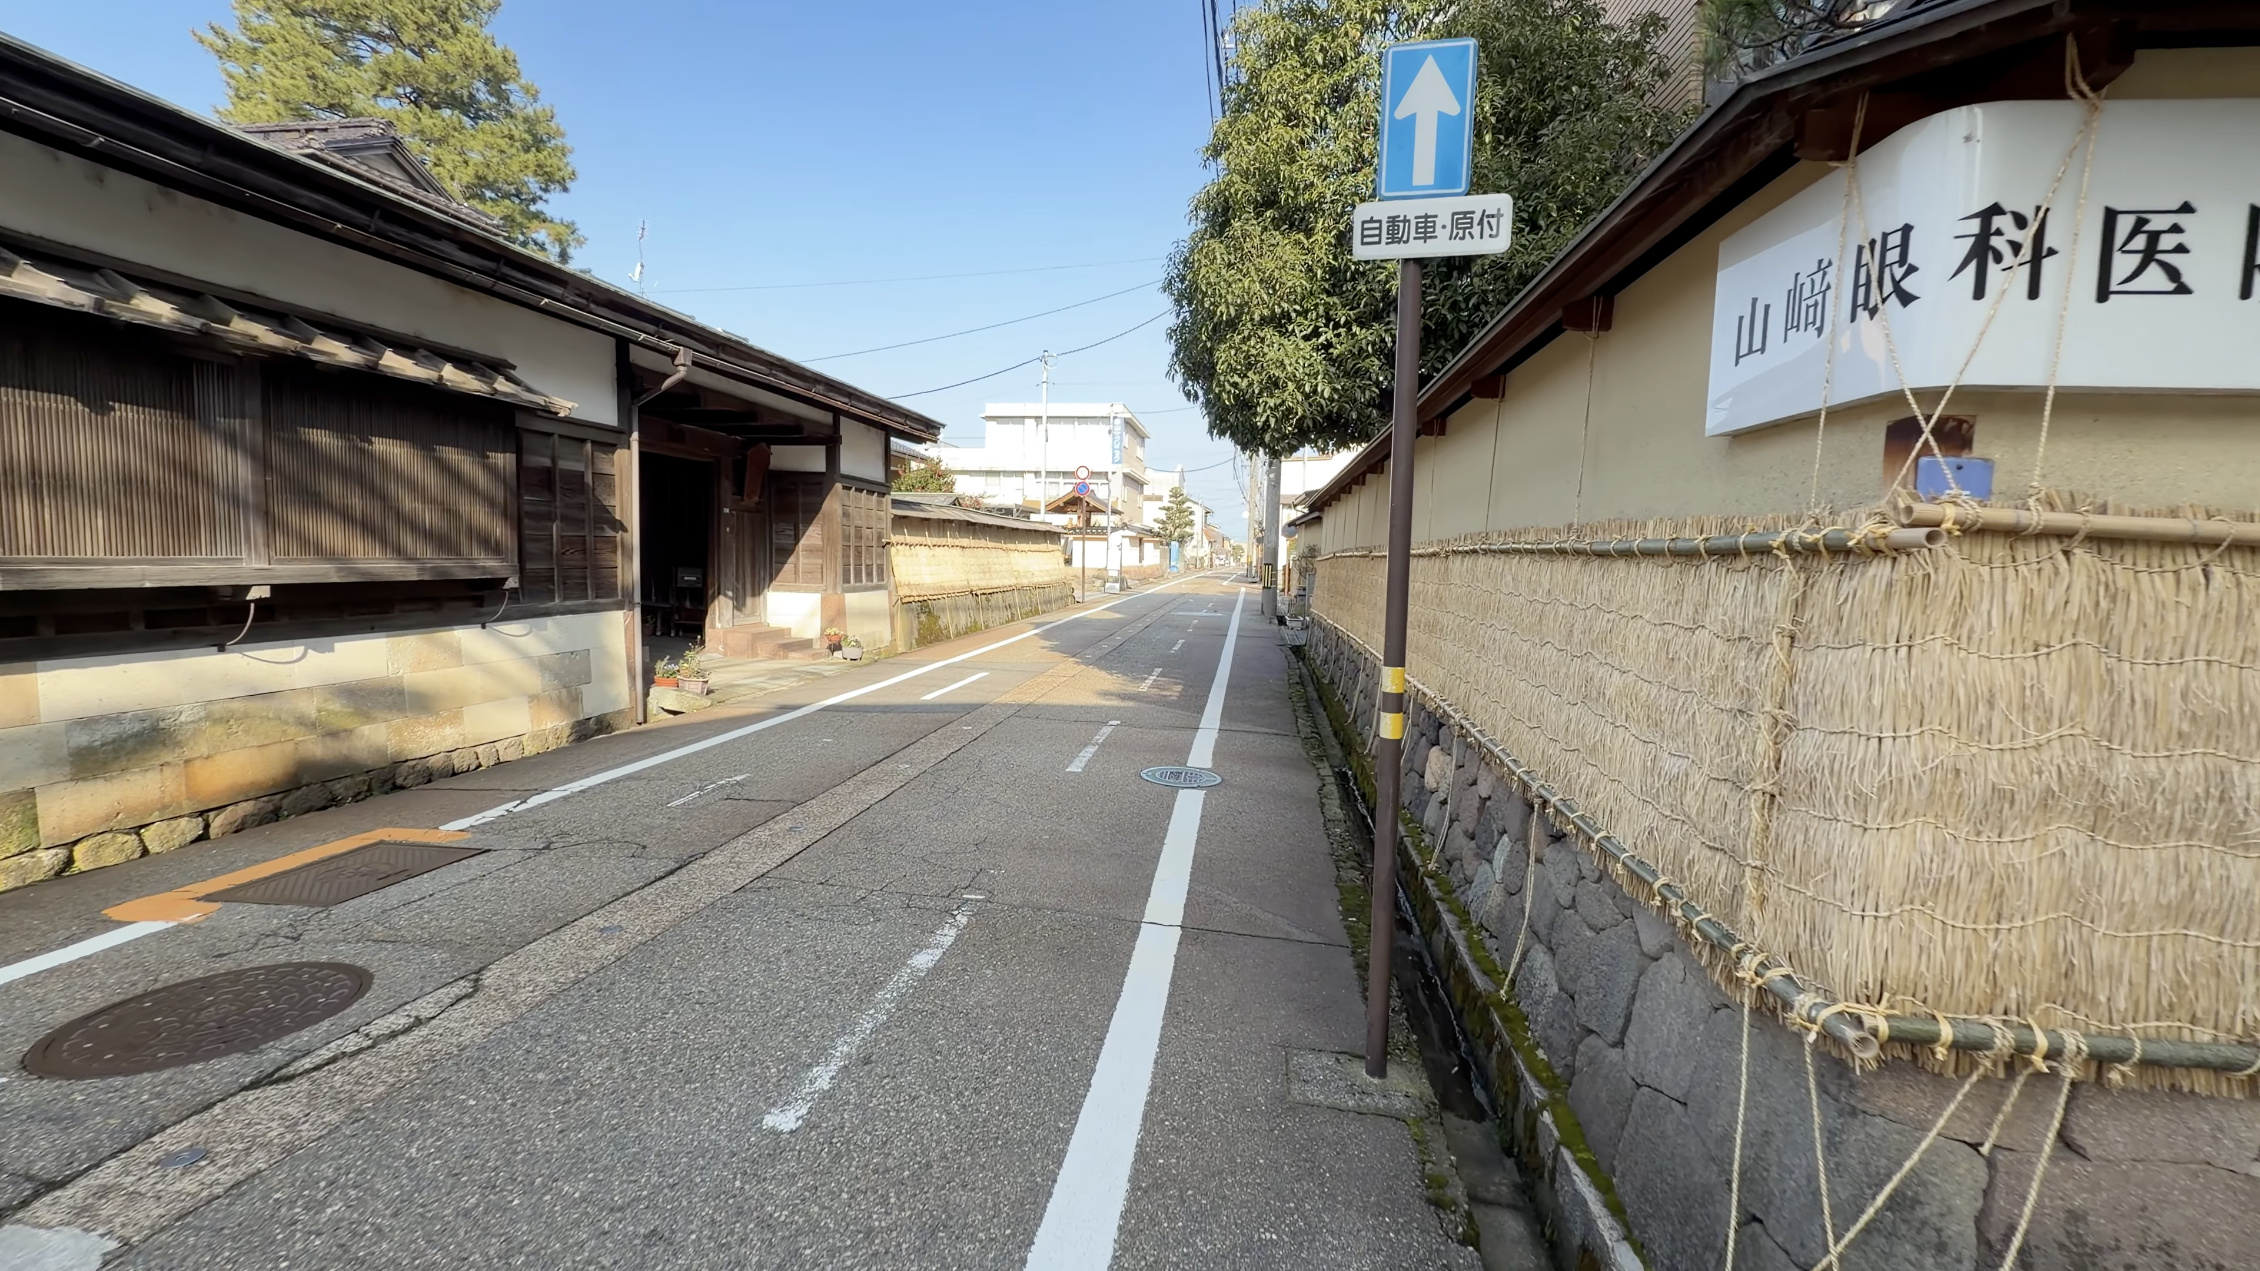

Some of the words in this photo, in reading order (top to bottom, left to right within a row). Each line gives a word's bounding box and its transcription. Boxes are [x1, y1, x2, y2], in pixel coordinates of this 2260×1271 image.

[1733, 200, 2260, 368] 山﨑眼科医
